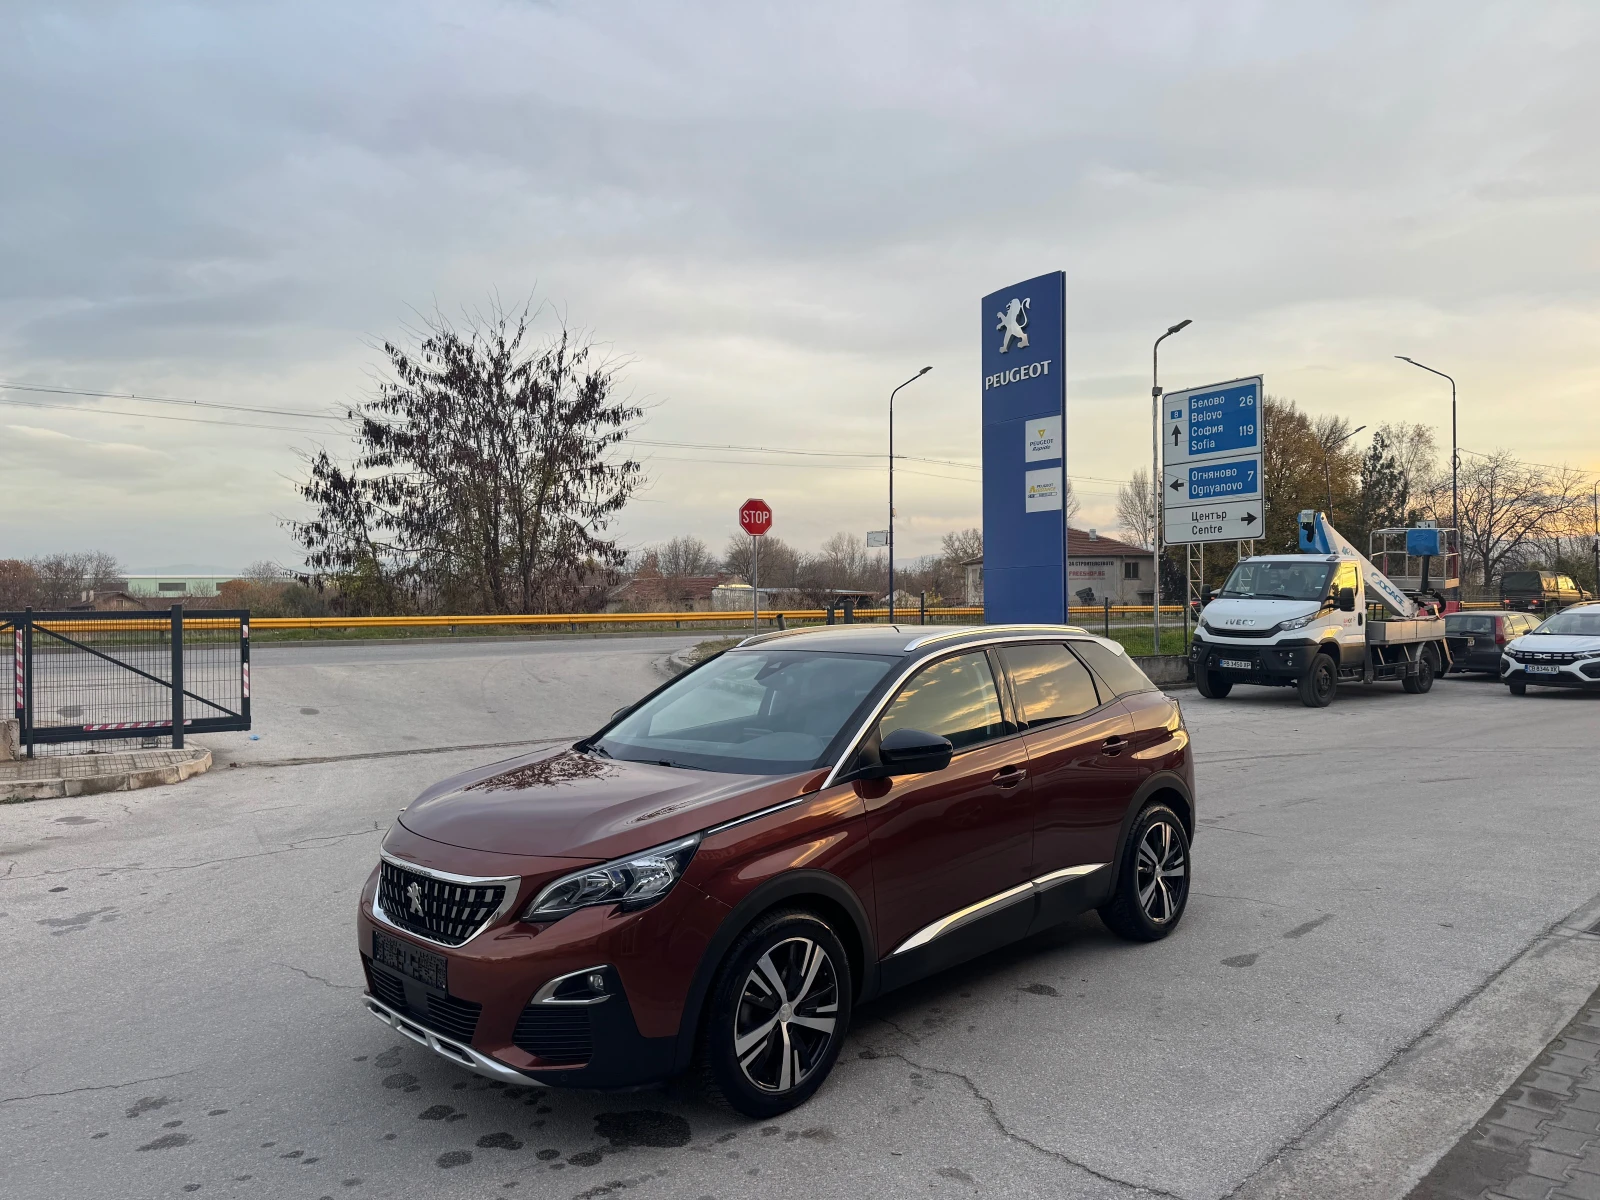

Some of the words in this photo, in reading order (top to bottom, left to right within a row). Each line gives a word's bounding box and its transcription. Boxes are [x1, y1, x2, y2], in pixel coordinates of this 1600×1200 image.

[985, 360, 1052, 391] PEUGEOT
[1191, 396, 1225, 409] Белово
[1239, 395, 1254, 407] 26
[1191, 410, 1223, 423] Belovo
[1191, 424, 1224, 437] София
[1239, 424, 1254, 437] 119
[1029, 438, 1054, 447] PEUGEOT
[1191, 438, 1216, 451] Sofia
[1191, 468, 1237, 481] Огняново
[1247, 470, 1254, 481] 7
[1191, 482, 1243, 496] Ognyanovo
[742, 510, 770, 524] STOP
[1191, 511, 1227, 522] Център
[1191, 525, 1223, 535] Centre
